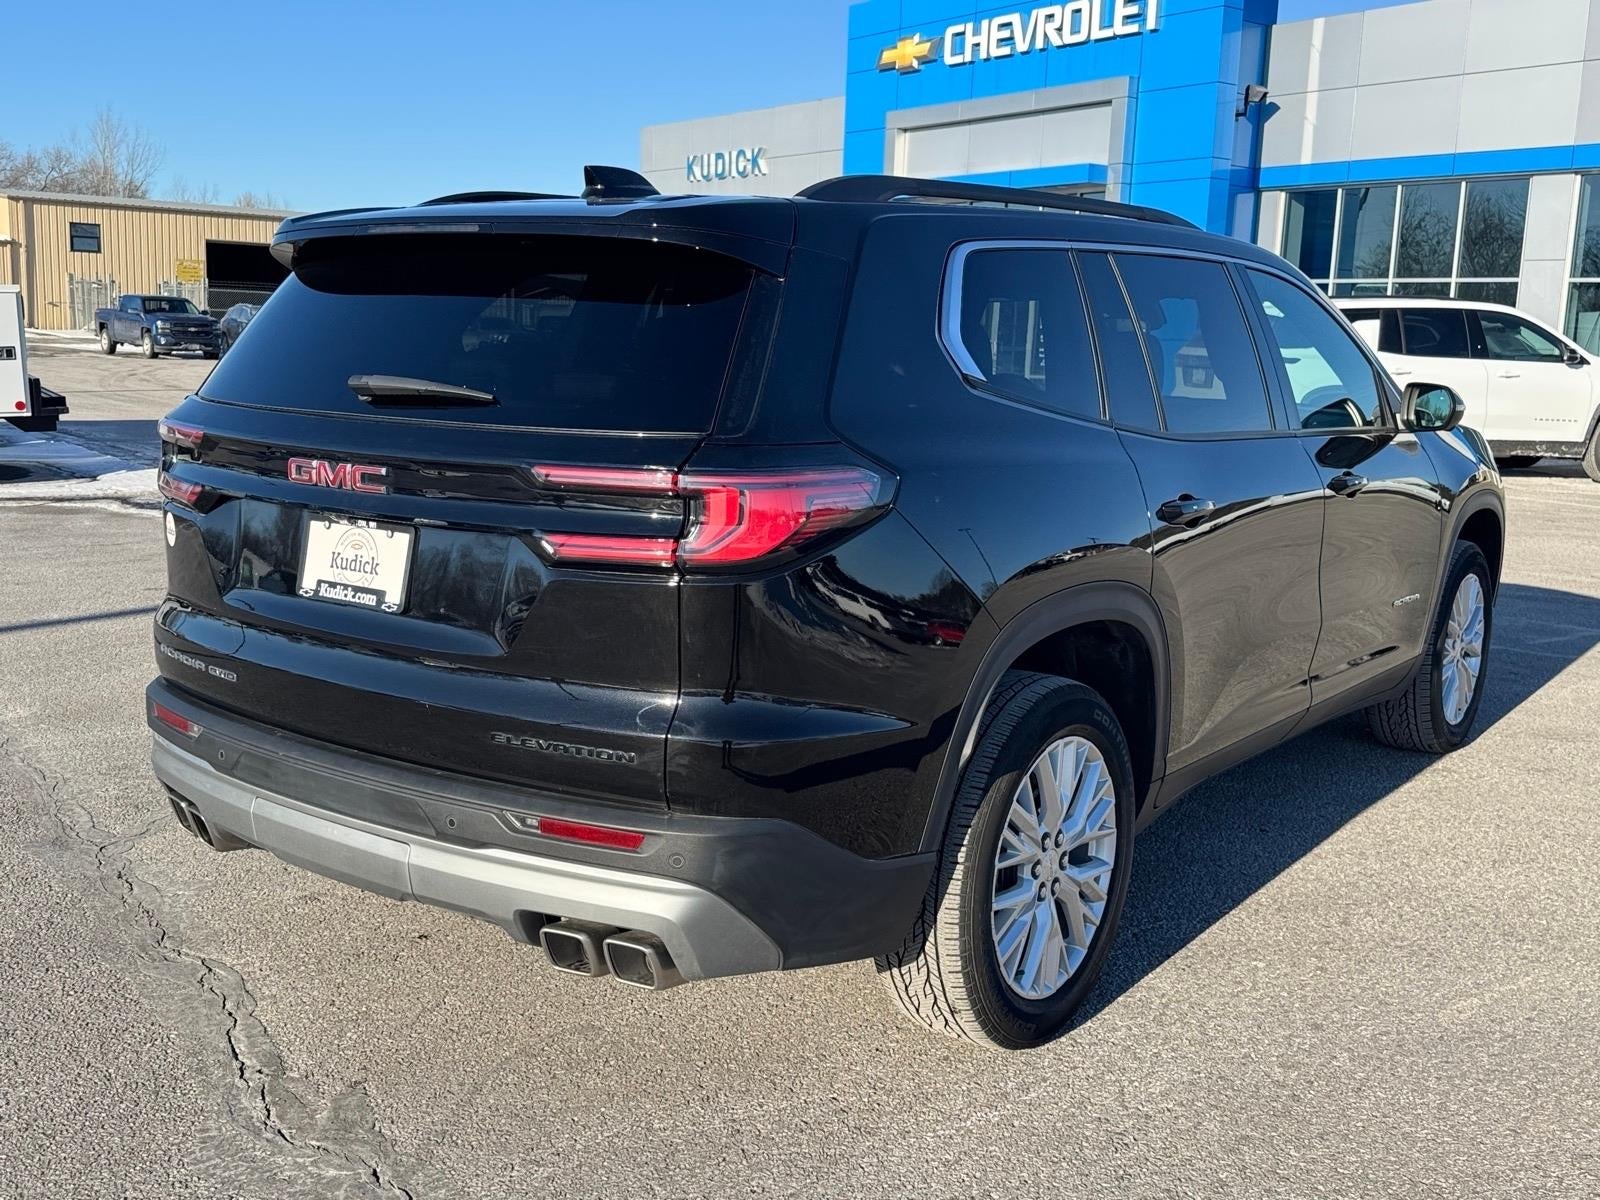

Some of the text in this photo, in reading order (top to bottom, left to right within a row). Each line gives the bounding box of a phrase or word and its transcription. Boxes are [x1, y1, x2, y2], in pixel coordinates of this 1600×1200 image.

[687, 147, 767, 183] KUDICK
[287, 457, 387, 495] GMC
[330, 551, 380, 576] Kudick
[318, 582, 377, 606] Kudick.com
[161, 642, 206, 672] ACADIA
[489, 731, 638, 764] ELEVATION
